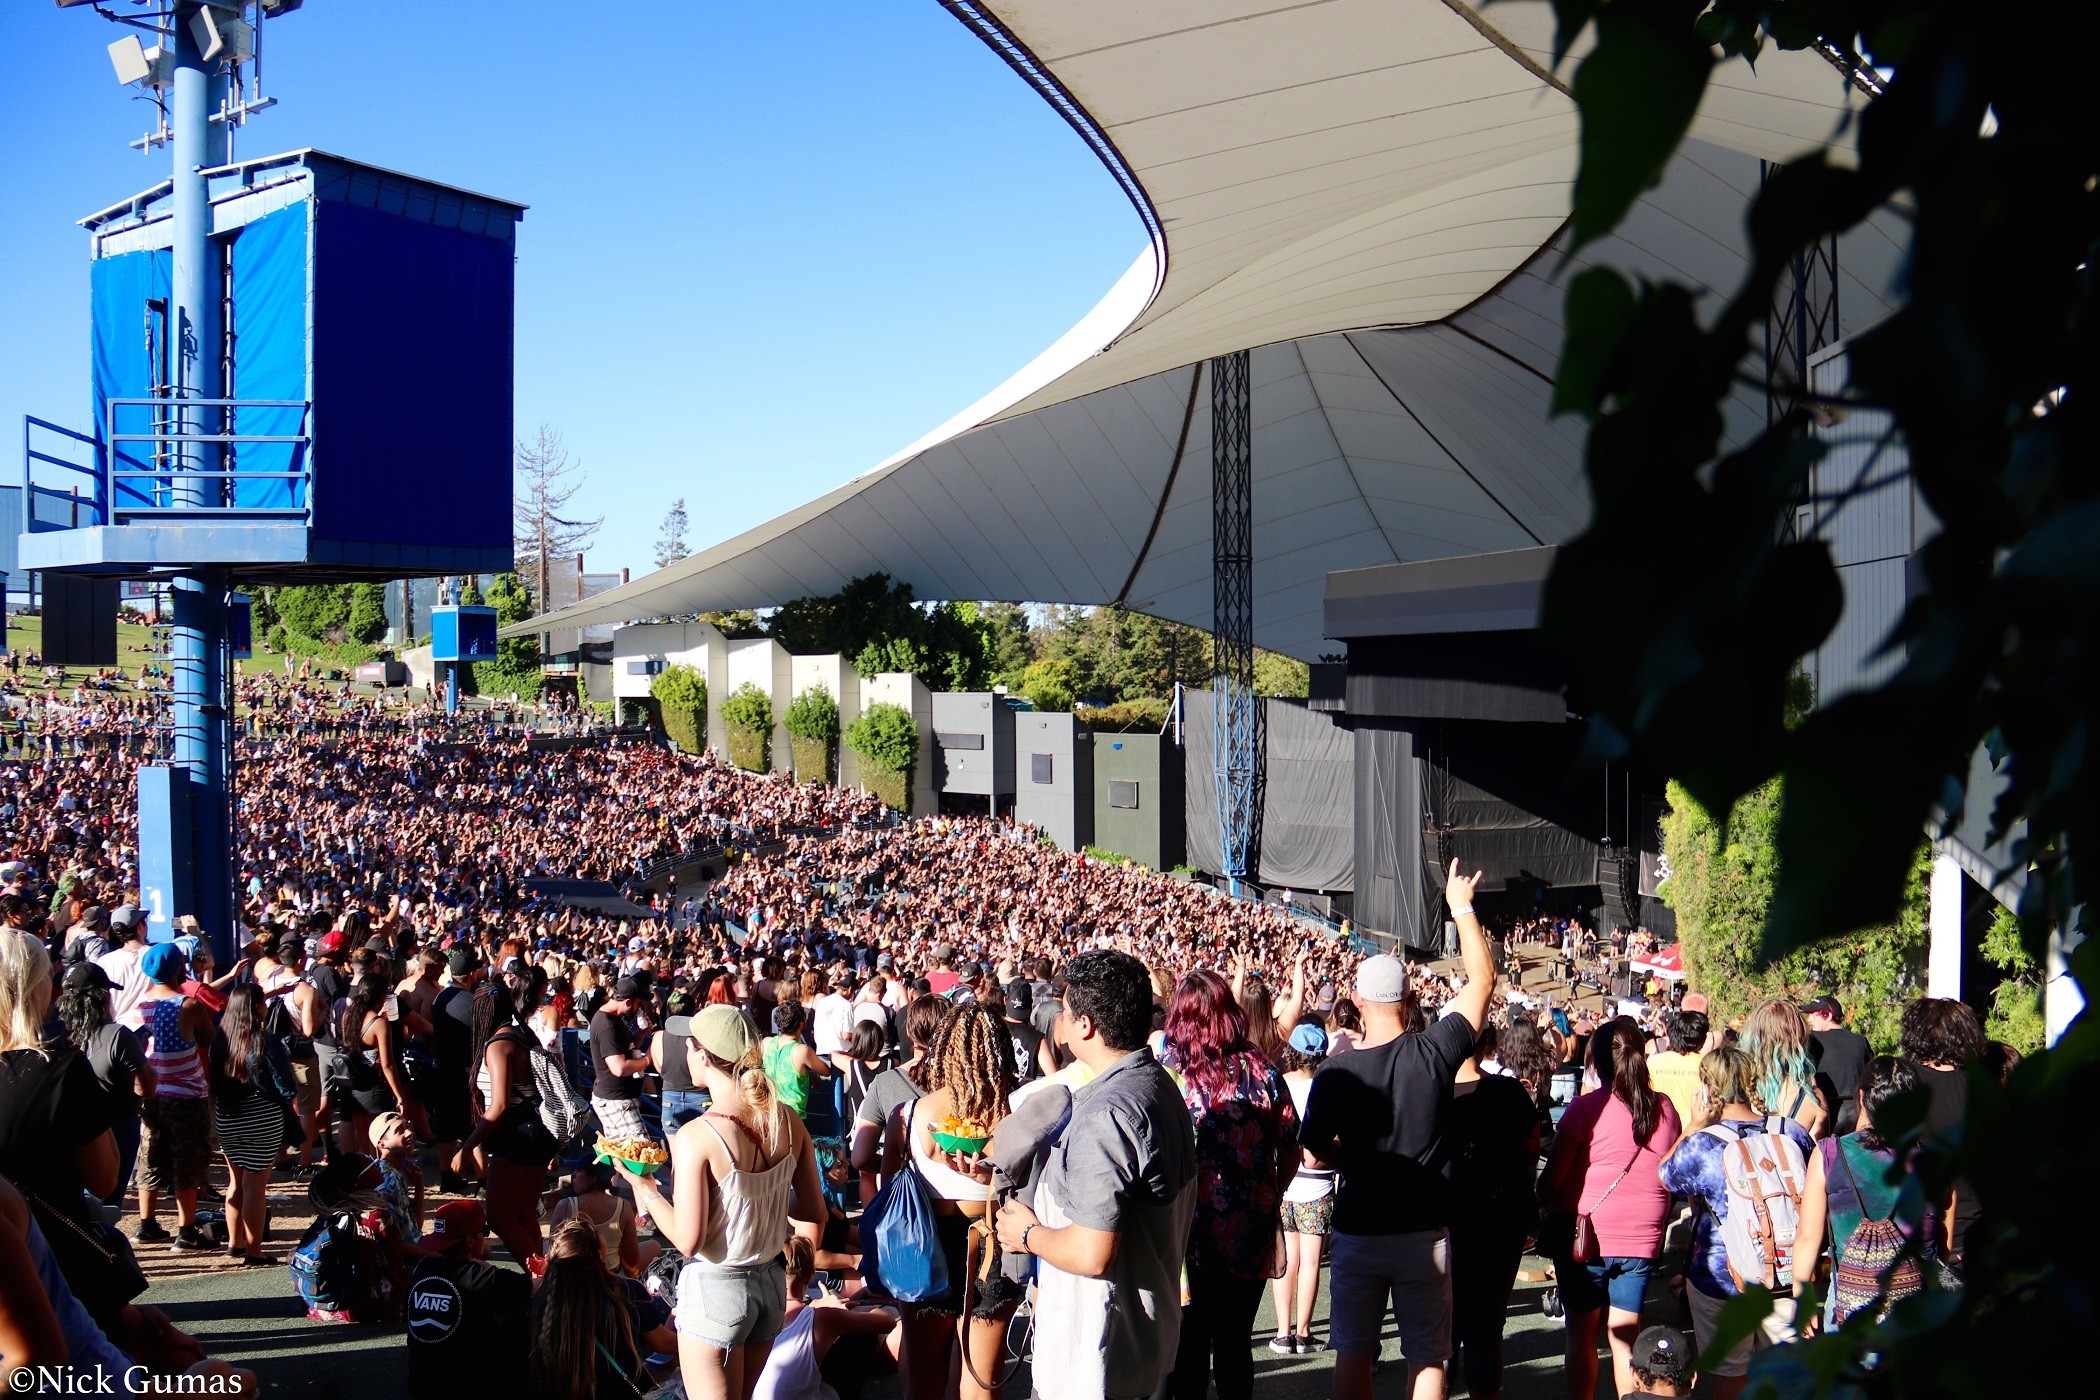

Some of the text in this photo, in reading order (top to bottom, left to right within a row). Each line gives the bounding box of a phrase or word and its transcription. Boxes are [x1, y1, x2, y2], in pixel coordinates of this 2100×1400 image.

[149, 889, 166, 923] 1
[1655, 1068, 1686, 1077] KNUCKLE
[414, 1291, 453, 1312] VANS
